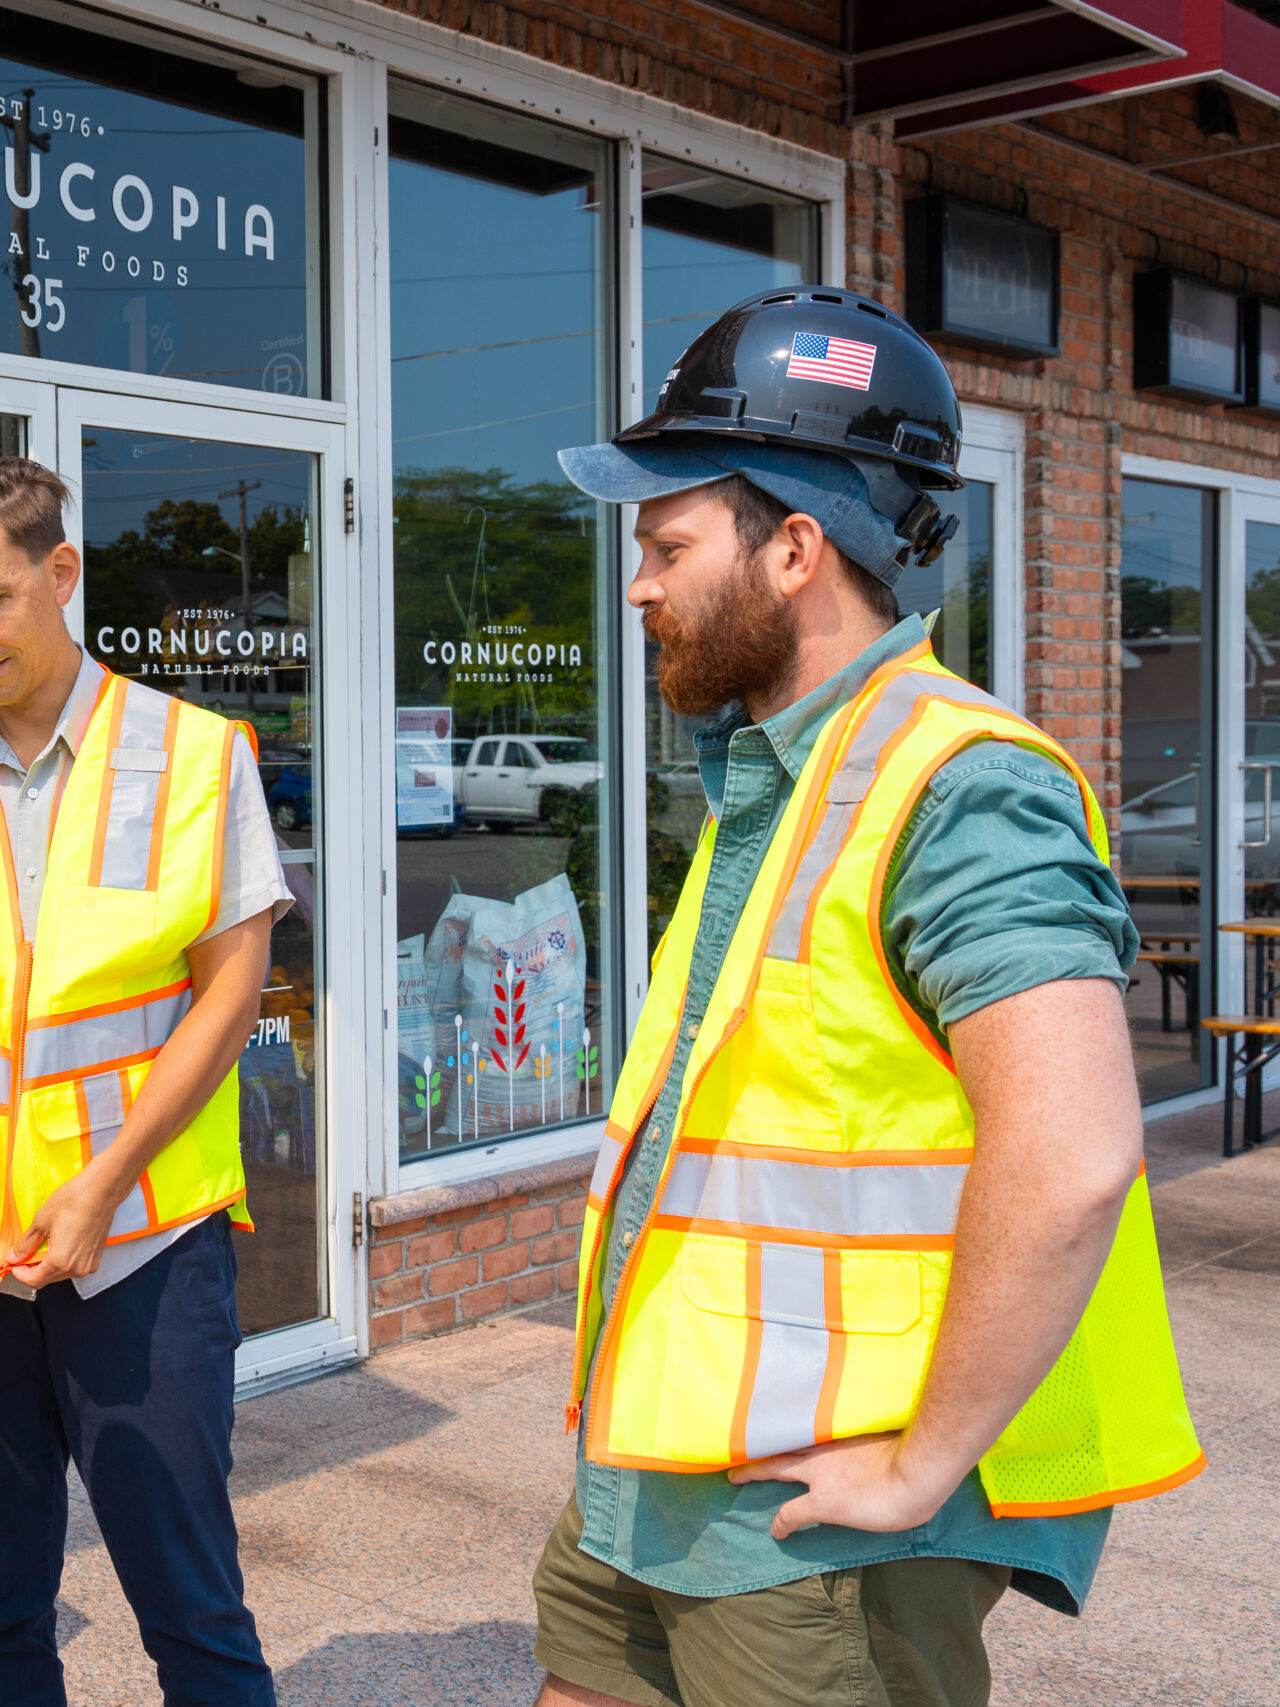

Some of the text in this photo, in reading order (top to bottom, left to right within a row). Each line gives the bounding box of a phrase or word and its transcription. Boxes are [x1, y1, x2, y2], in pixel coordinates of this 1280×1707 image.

[37, 106, 90, 138] 1976
[77, 245, 188, 287] FOODS
[21, 273, 66, 332] 35
[183, 609, 229, 619] EST 1976
[97, 627, 307, 657] CORNUCOPIA
[487, 625, 522, 634] EST 1976
[423, 641, 582, 666] CORNUCOPIA
[141, 664, 270, 675] NATURAL FOODS
[456, 673, 553, 683] NATURAL FOODS
